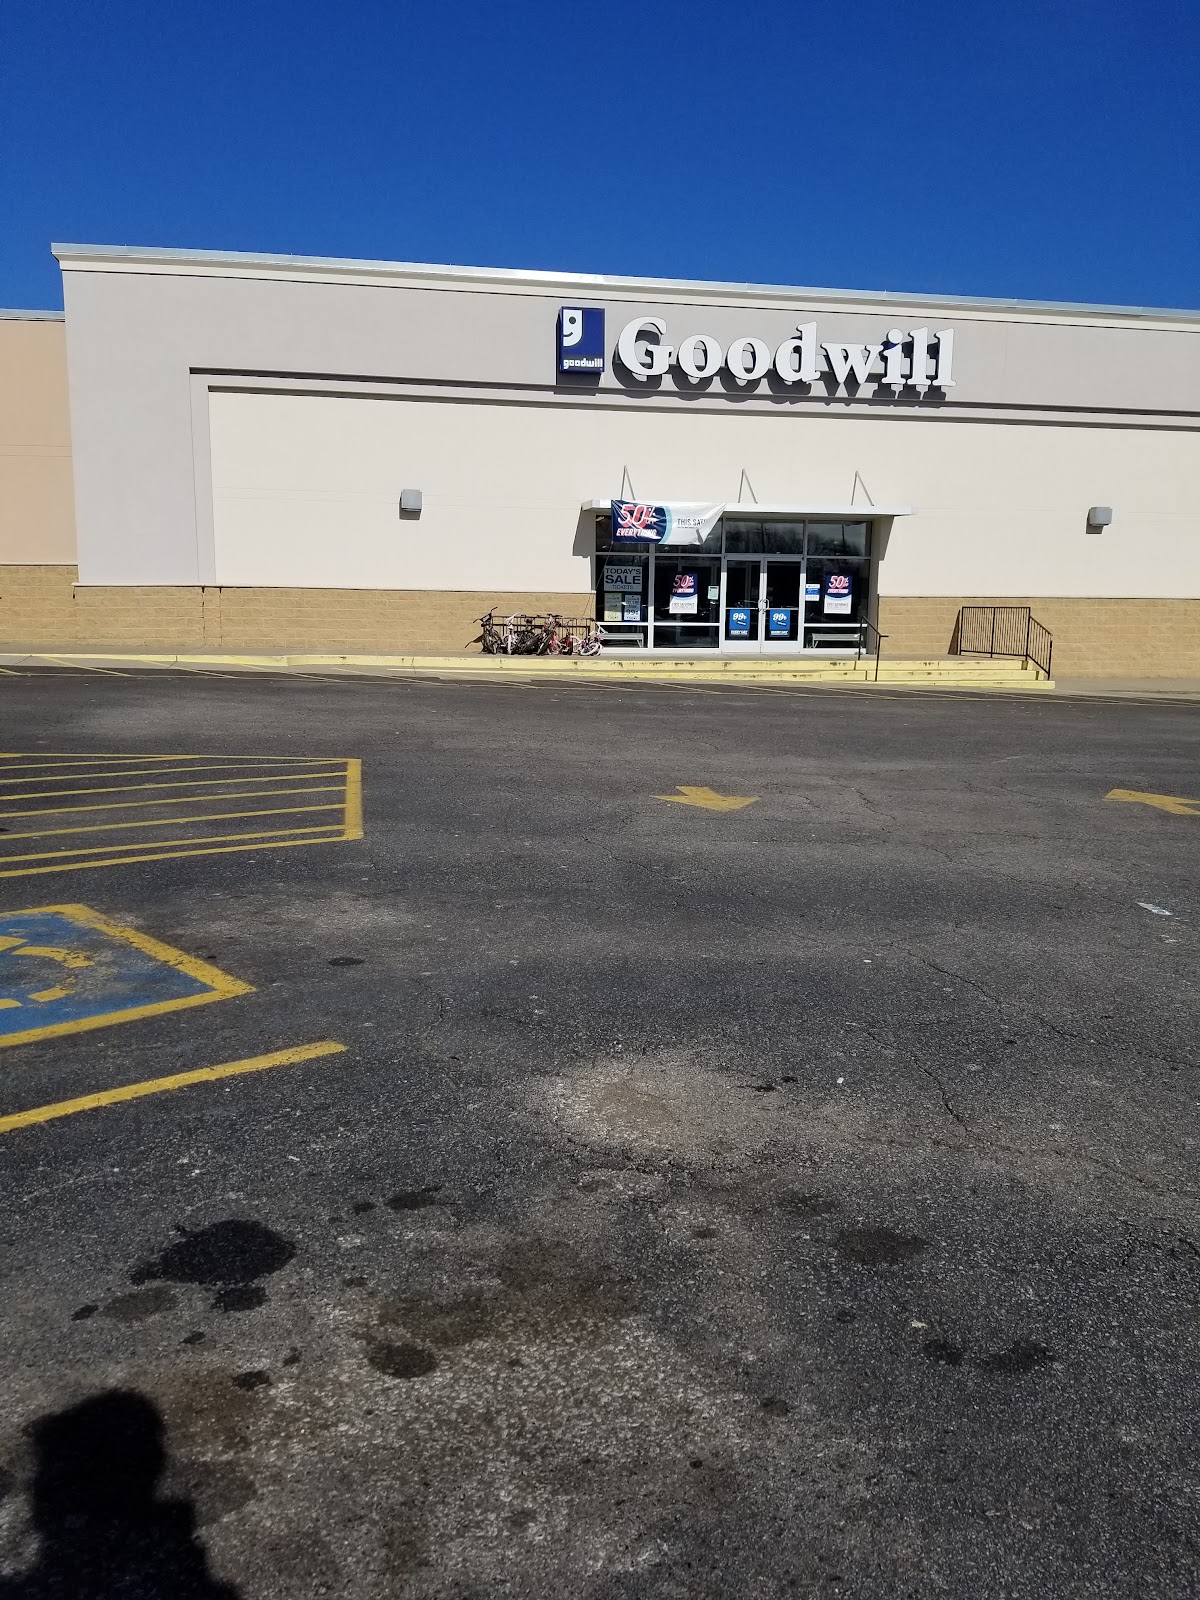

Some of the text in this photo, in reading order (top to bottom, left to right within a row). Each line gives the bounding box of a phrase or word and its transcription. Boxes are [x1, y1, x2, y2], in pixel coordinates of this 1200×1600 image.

[618, 316, 957, 387] Goodwill
[563, 357, 603, 370] goodwill
[677, 518, 692, 526] THIS
[605, 567, 642, 575] TODAY'S
[605, 574, 641, 585] SALE
